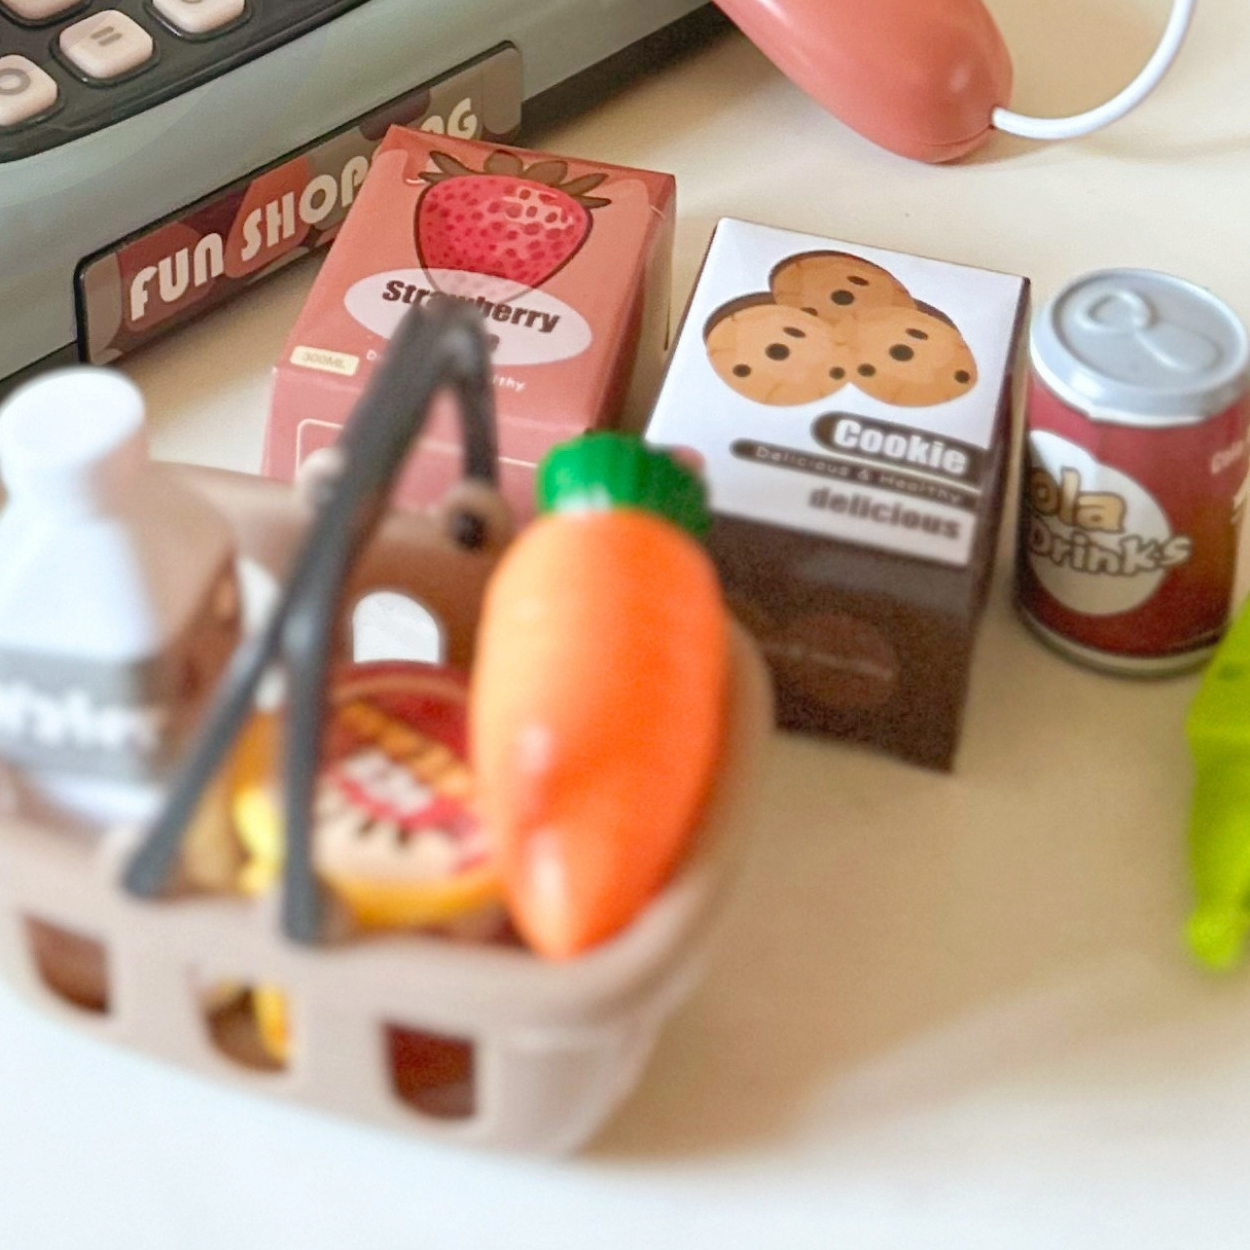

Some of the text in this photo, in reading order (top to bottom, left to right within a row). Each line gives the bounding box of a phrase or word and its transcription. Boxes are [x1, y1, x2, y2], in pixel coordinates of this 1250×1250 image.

[130, 232, 224, 322] FUN
[755, 445, 849, 477] Delicious
[833, 419, 969, 475] Cookie
[809, 486, 962, 540] delicious
[1029, 465, 1128, 534] ola
[1029, 516, 1193, 578] Drinks
